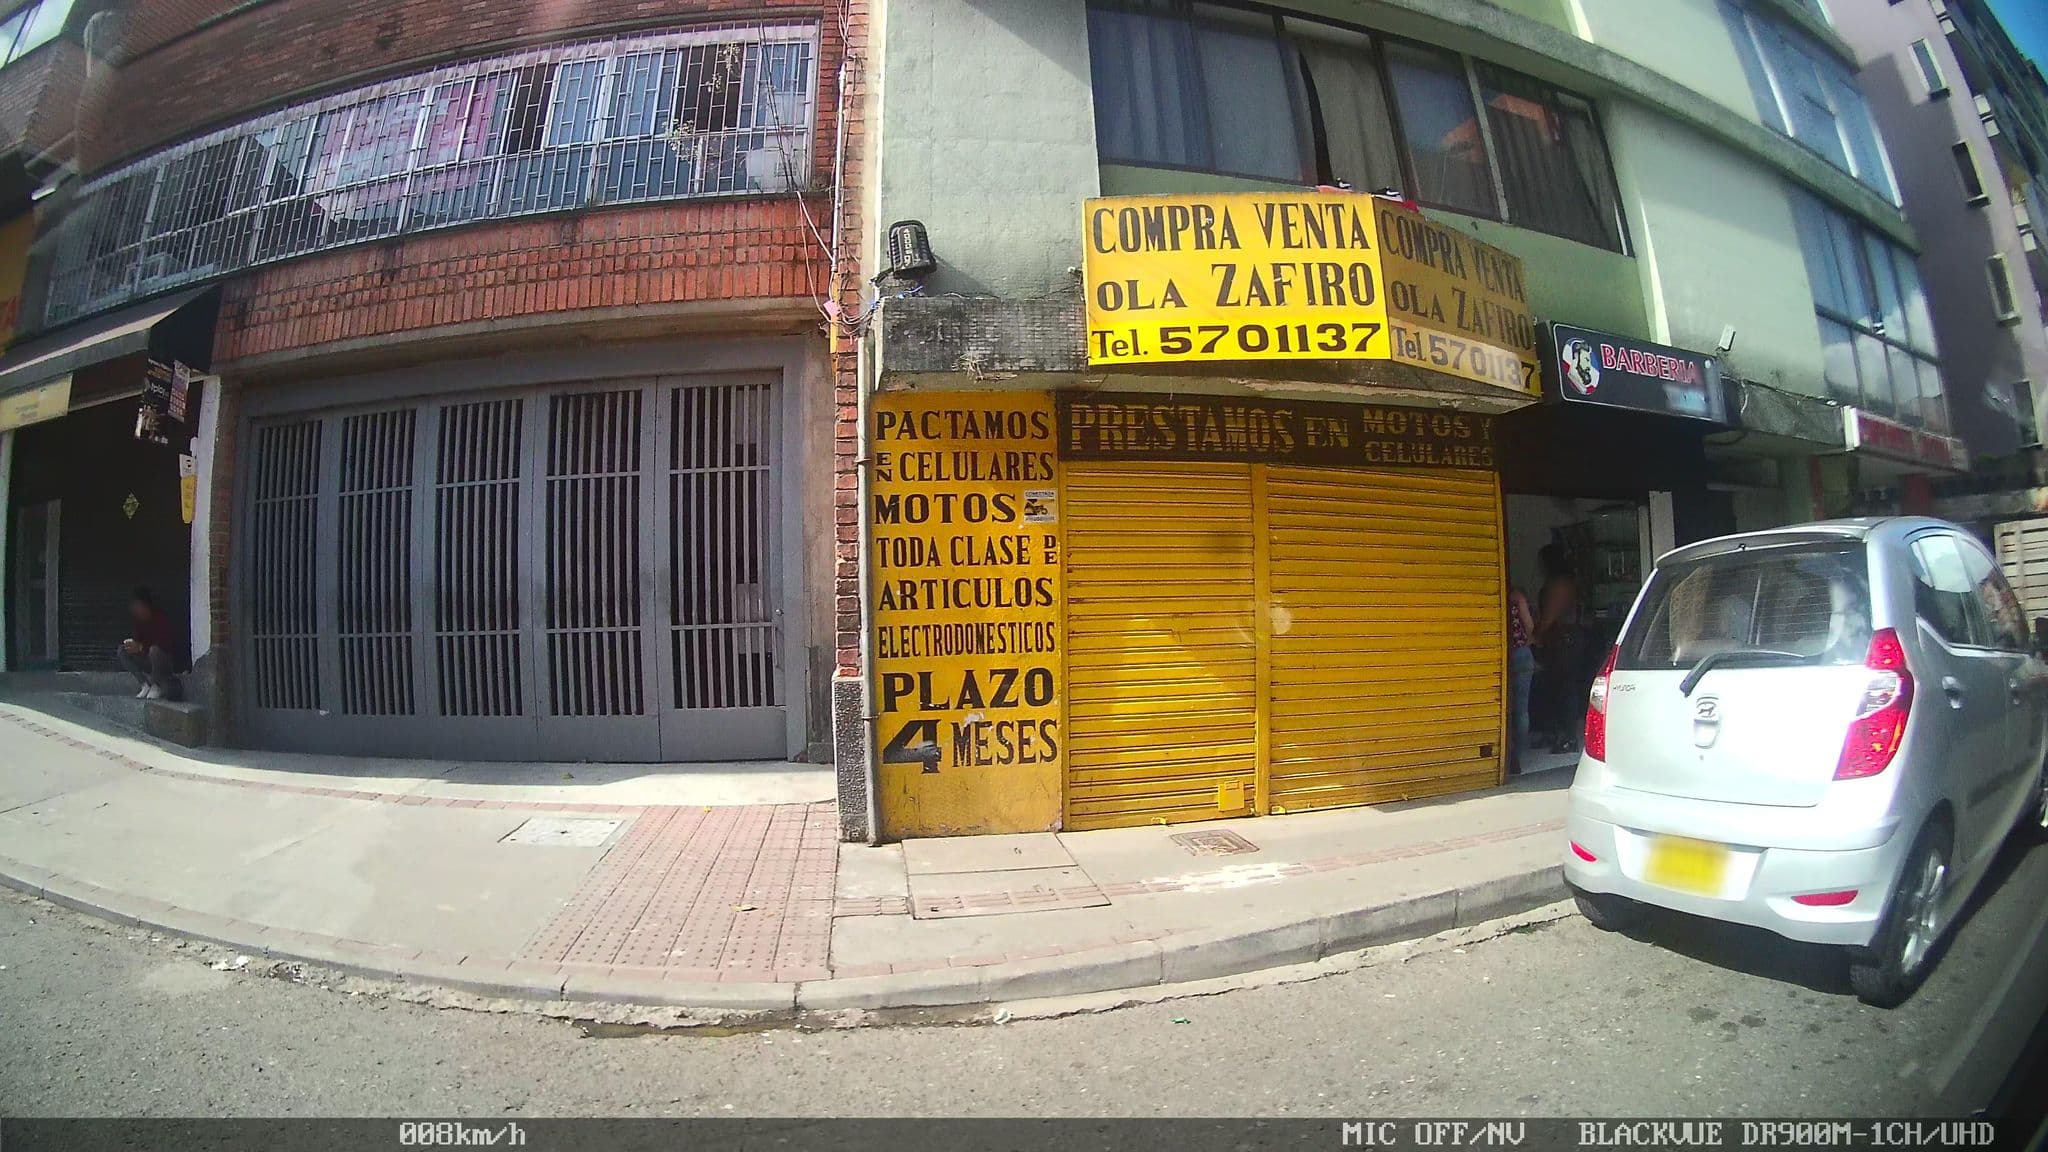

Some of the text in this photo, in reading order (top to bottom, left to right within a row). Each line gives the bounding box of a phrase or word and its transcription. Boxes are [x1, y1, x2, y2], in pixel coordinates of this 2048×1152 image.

[1094, 202, 1371, 254] COMPRA VENTA
[1381, 210, 1526, 304] COMPRA VENTA
[1097, 262, 1375, 312] OLA ZAFIRO
[1390, 280, 1532, 350] OLA ZAFIRO
[1092, 323, 1381, 358] Tel. 5701137
[1428, 334, 1535, 389] 5701137
[1600, 343, 1699, 384] BARBERIA
[875, 410, 1050, 441] PACTAMOS
[1071, 404, 1349, 455] PRESTAMOS EN
[1363, 407, 1492, 440] MOTOS Y
[900, 451, 1054, 482] CELULARES
[1364, 440, 1494, 466] CELULARES
[874, 493, 1017, 525] MOTOS
[876, 536, 941, 568] TODA
[950, 535, 1031, 567] CLASE
[878, 577, 1053, 611] ARTICULOS
[881, 667, 1054, 713] PLAZO
[883, 718, 1058, 775] 4 MESES
